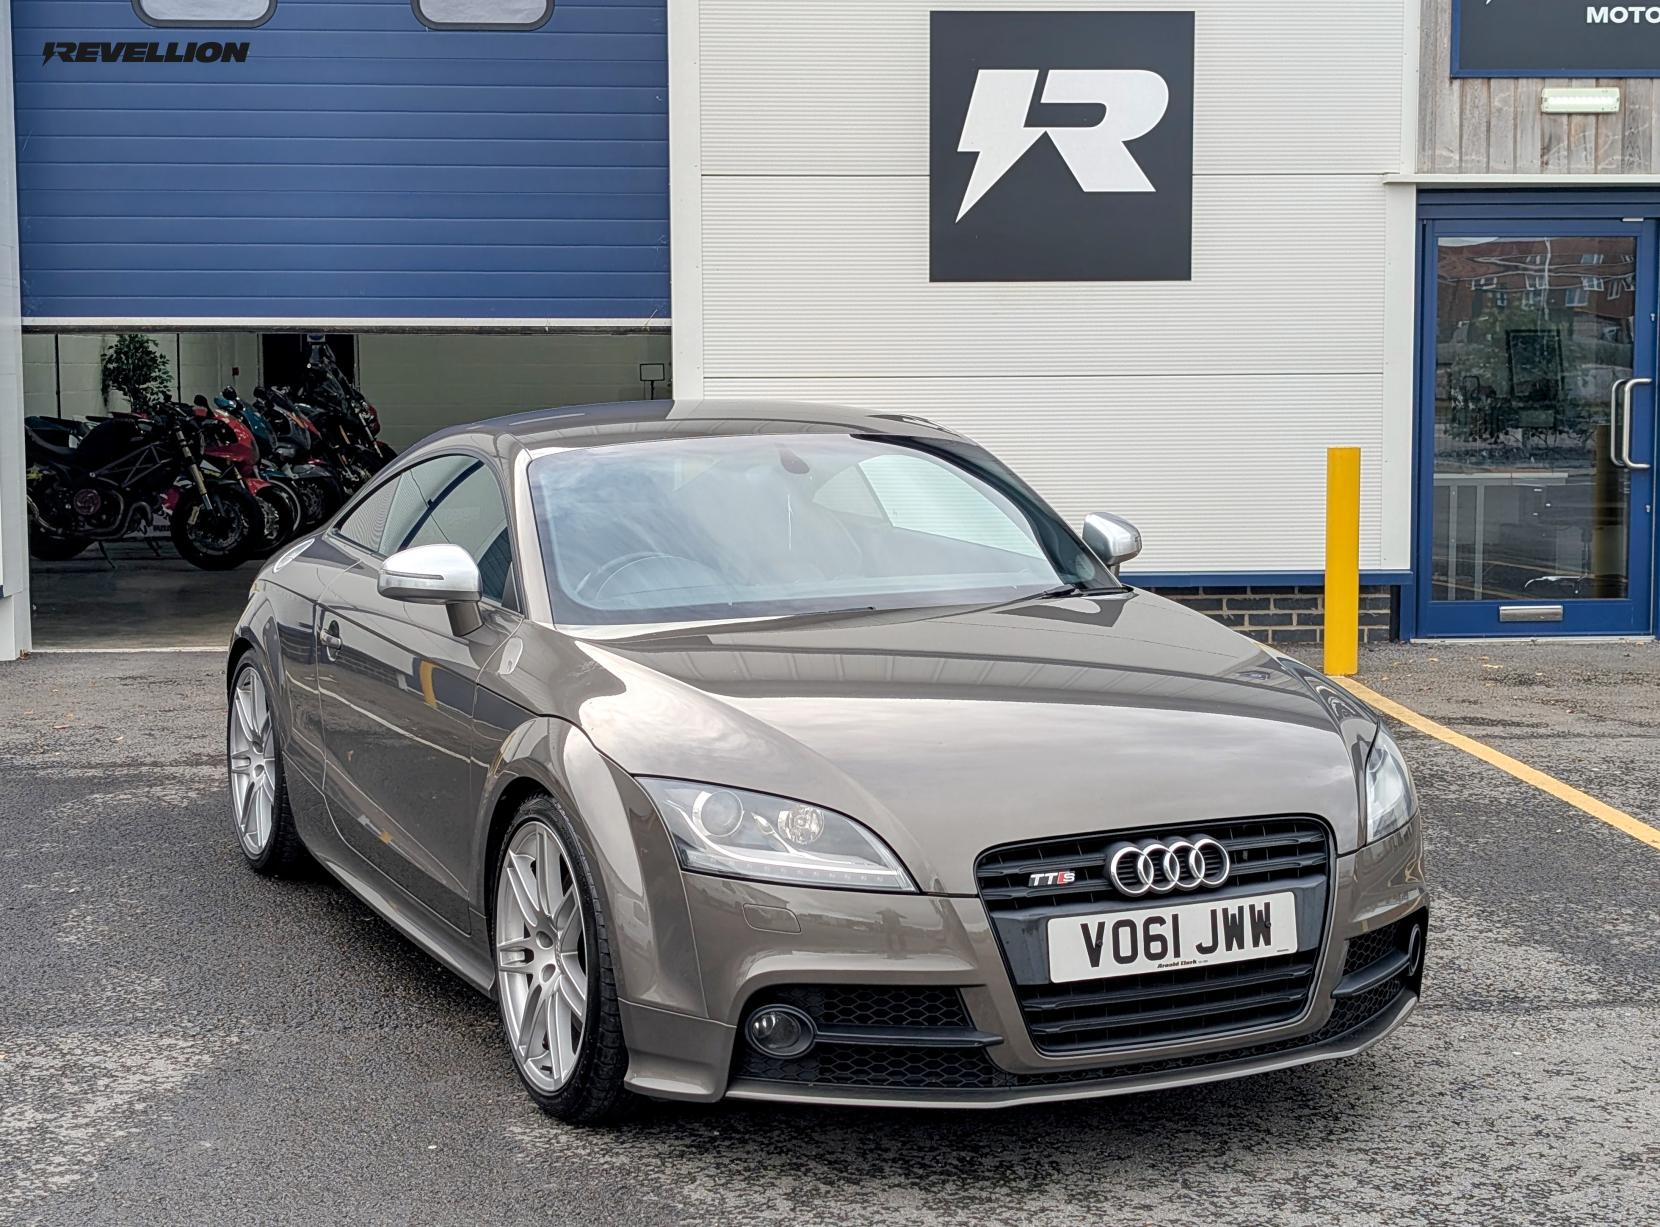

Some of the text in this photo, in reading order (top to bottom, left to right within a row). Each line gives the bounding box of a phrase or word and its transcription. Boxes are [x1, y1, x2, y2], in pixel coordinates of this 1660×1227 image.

[1586, 6, 1660, 23] MOTO
[1030, 871, 1076, 887] TTS
[1080, 902, 1272, 968] VO61 JWW
